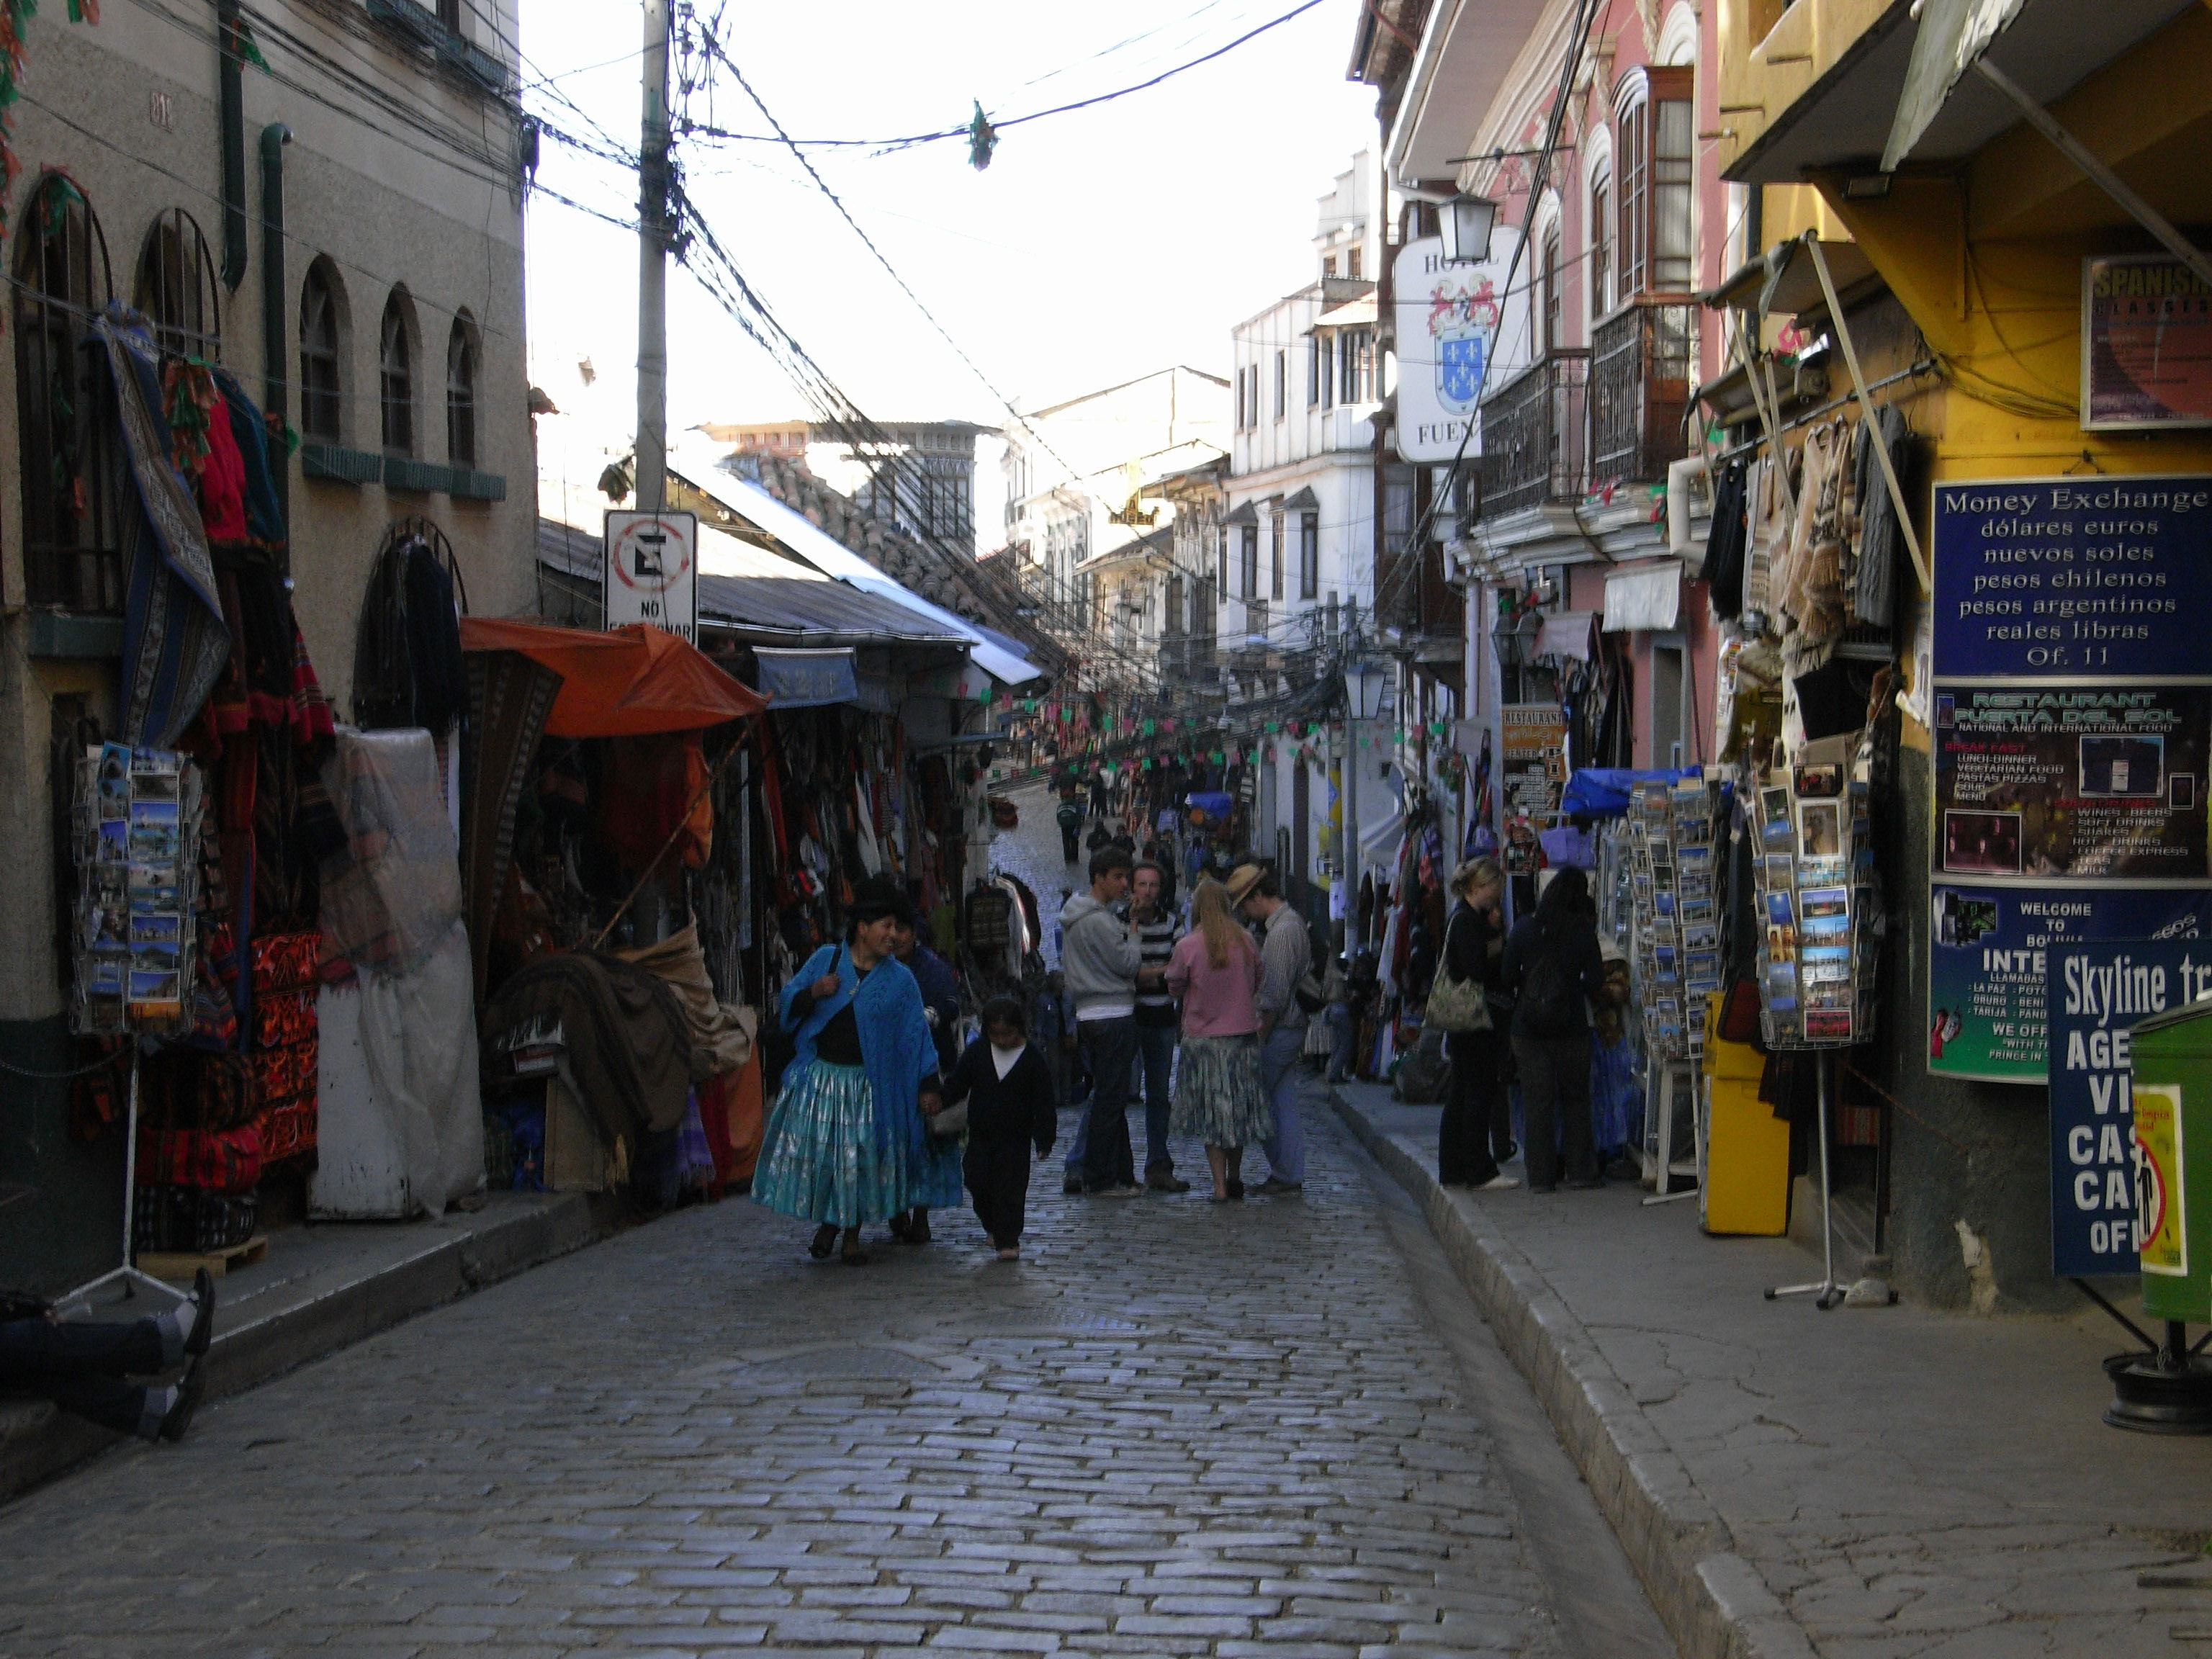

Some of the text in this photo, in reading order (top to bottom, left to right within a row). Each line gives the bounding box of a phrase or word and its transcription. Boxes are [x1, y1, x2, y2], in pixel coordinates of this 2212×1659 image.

[1424, 248, 1499, 274] HOL
[1944, 487, 2208, 515] Money Exchange
[1981, 519, 2159, 538] dólares euros
[1984, 542, 2155, 563] nuevos soles
[1974, 569, 2167, 594] pesos chilenos
[641, 601, 660, 618] NO
[1959, 594, 2177, 619] pesos argentinos
[1987, 620, 2149, 640] reales libras
[2084, 646, 2108, 665] 11
[1973, 693, 2157, 708] RESTAURANT
[1954, 709, 2182, 724] PUERTA DEL SOL
[1959, 723, 2172, 733] NATIONAL AND INTERNATIONAL FOOD
[1957, 763, 2064, 774] VEGETARIAN FOOD
[1957, 773, 2046, 783] PASTAS PIZZAS
[2077, 808, 2121, 817] WINES
[2077, 817, 2164, 827] SOFT DRINKS
[2072, 837, 2160, 846] HOT DRINKS
[2077, 847, 2188, 855] COFFEE EXPRESS
[2077, 866, 2107, 875] MILK
[2020, 902, 2092, 917] WELCOME
[2046, 919, 2065, 932] TO
[1983, 948, 2046, 974] INTE
[1990, 972, 2044, 984] LLAMADAS
[1973, 982, 1984, 993] LA
[1987, 984, 2006, 994] PAZ
[2064, 955, 2166, 1028] Skyline
[1973, 994, 2044, 1007] ORURO BENI
[1974, 1007, 2007, 1017] TARIJA
[1992, 1022, 2014, 1036] WE
[2031, 1051, 2041, 1061] IN
[2067, 1028, 2131, 1071] AGE
[2074, 1169, 2139, 1210] CA
